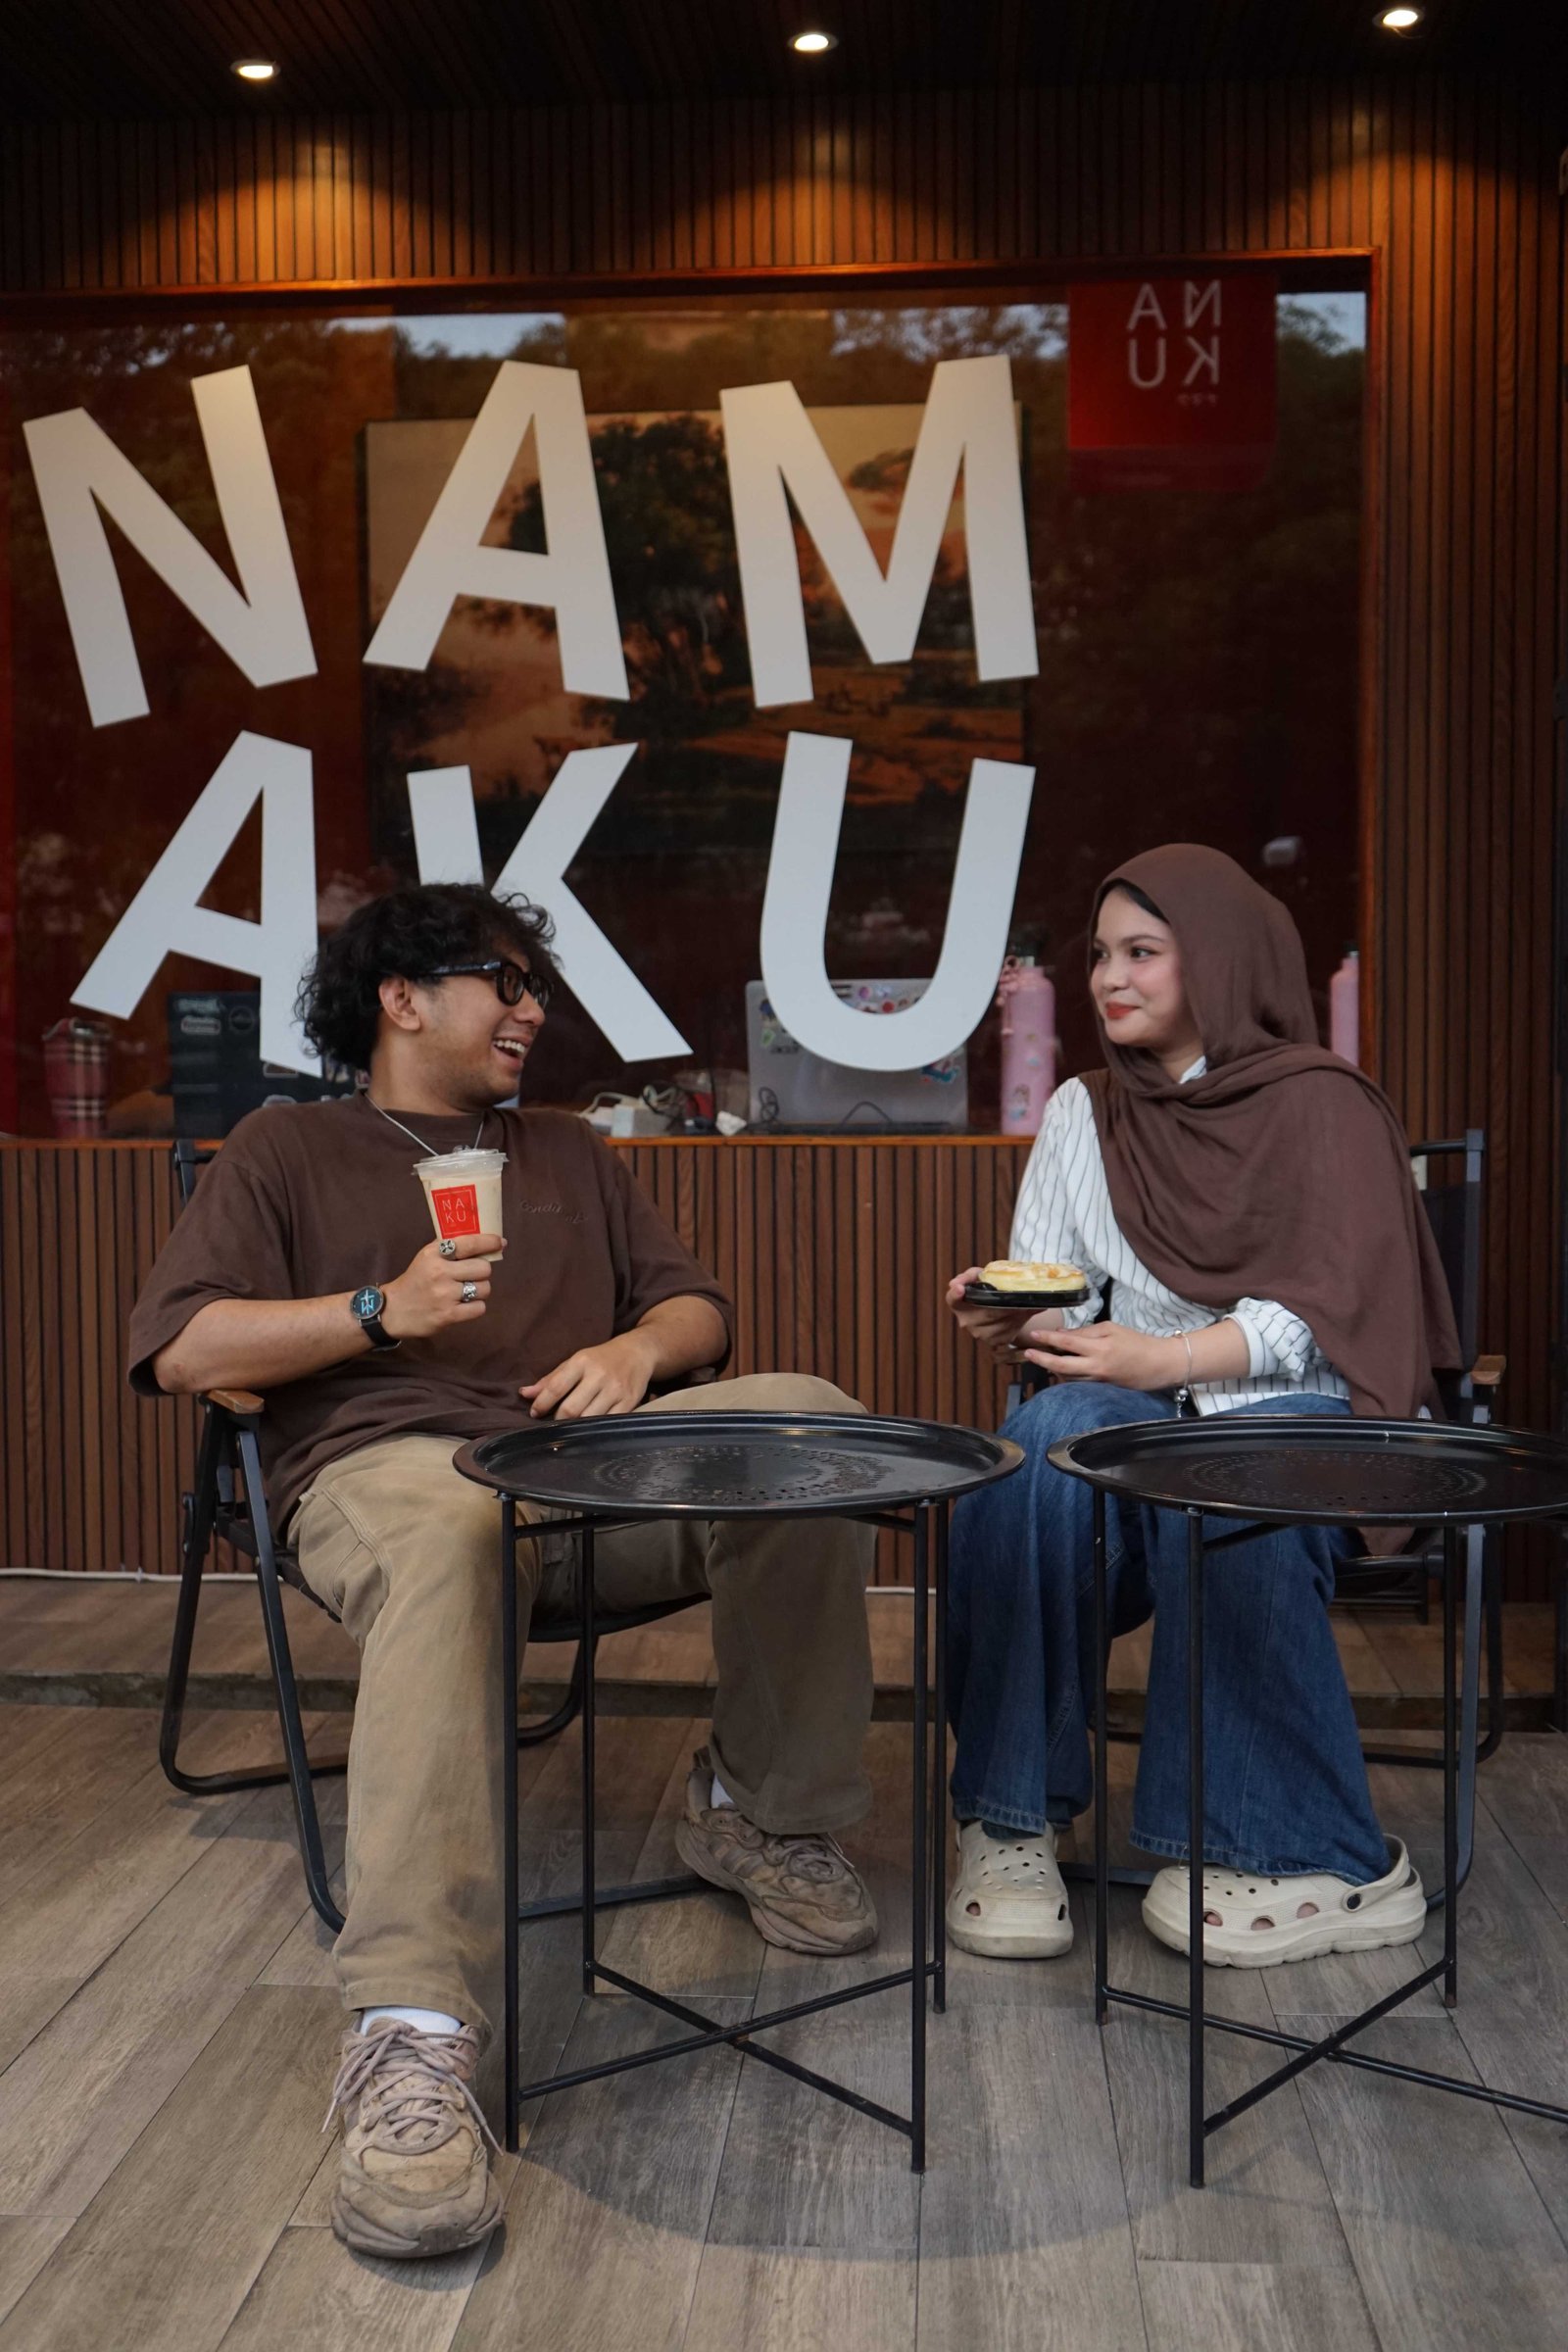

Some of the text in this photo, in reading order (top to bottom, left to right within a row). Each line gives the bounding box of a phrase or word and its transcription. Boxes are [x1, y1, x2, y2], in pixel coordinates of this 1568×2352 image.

[22, 354, 1040, 728] NAM
[70, 729, 1037, 1078] AKU
[441, 1198, 466, 1211] NA
[445, 1209, 466, 1224] KU
